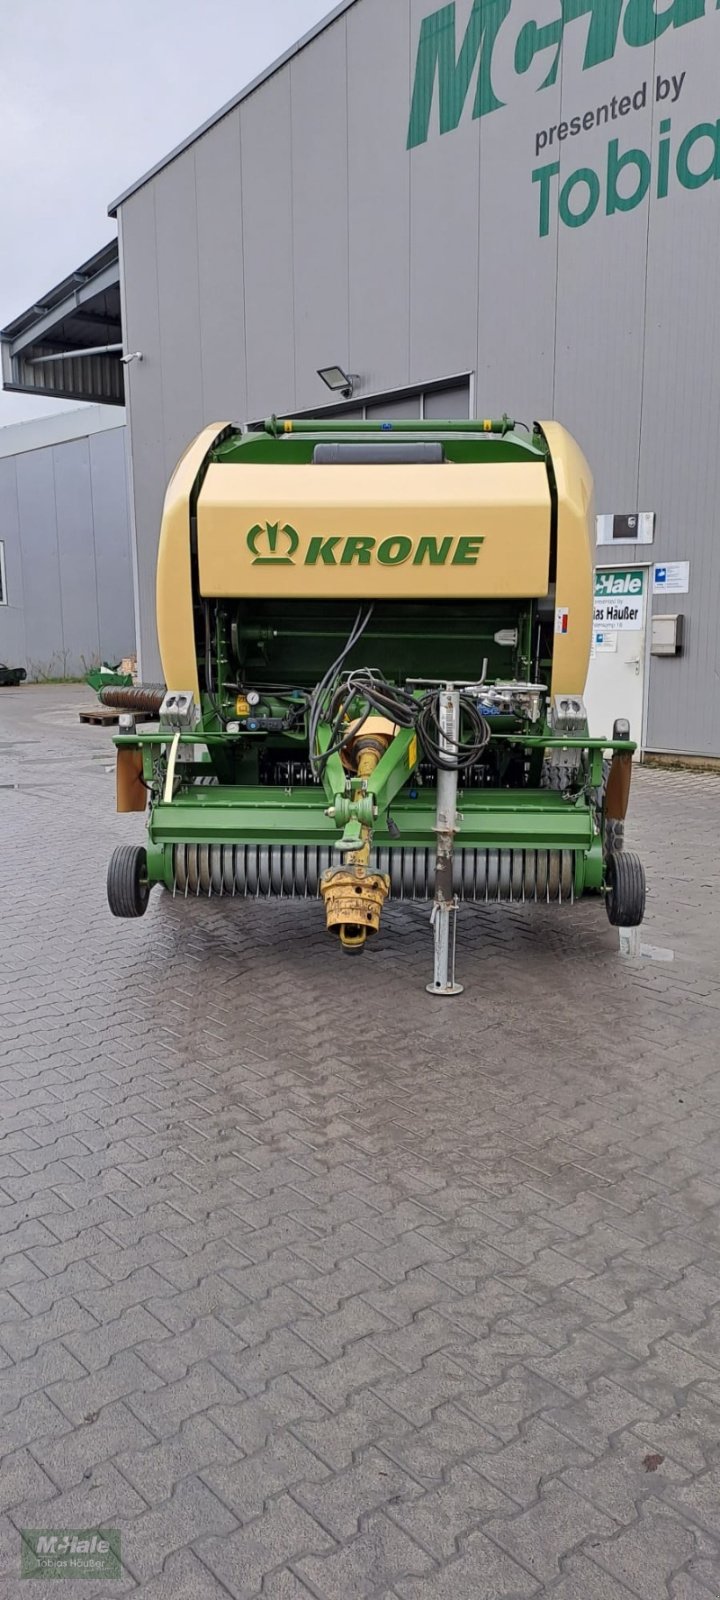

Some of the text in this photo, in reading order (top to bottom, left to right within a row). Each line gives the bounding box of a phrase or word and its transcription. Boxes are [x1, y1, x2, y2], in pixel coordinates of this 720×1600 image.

[535, 72, 686, 156] presented by
[303, 535, 486, 566] KRONE
[606, 605, 639, 620] Häußer
